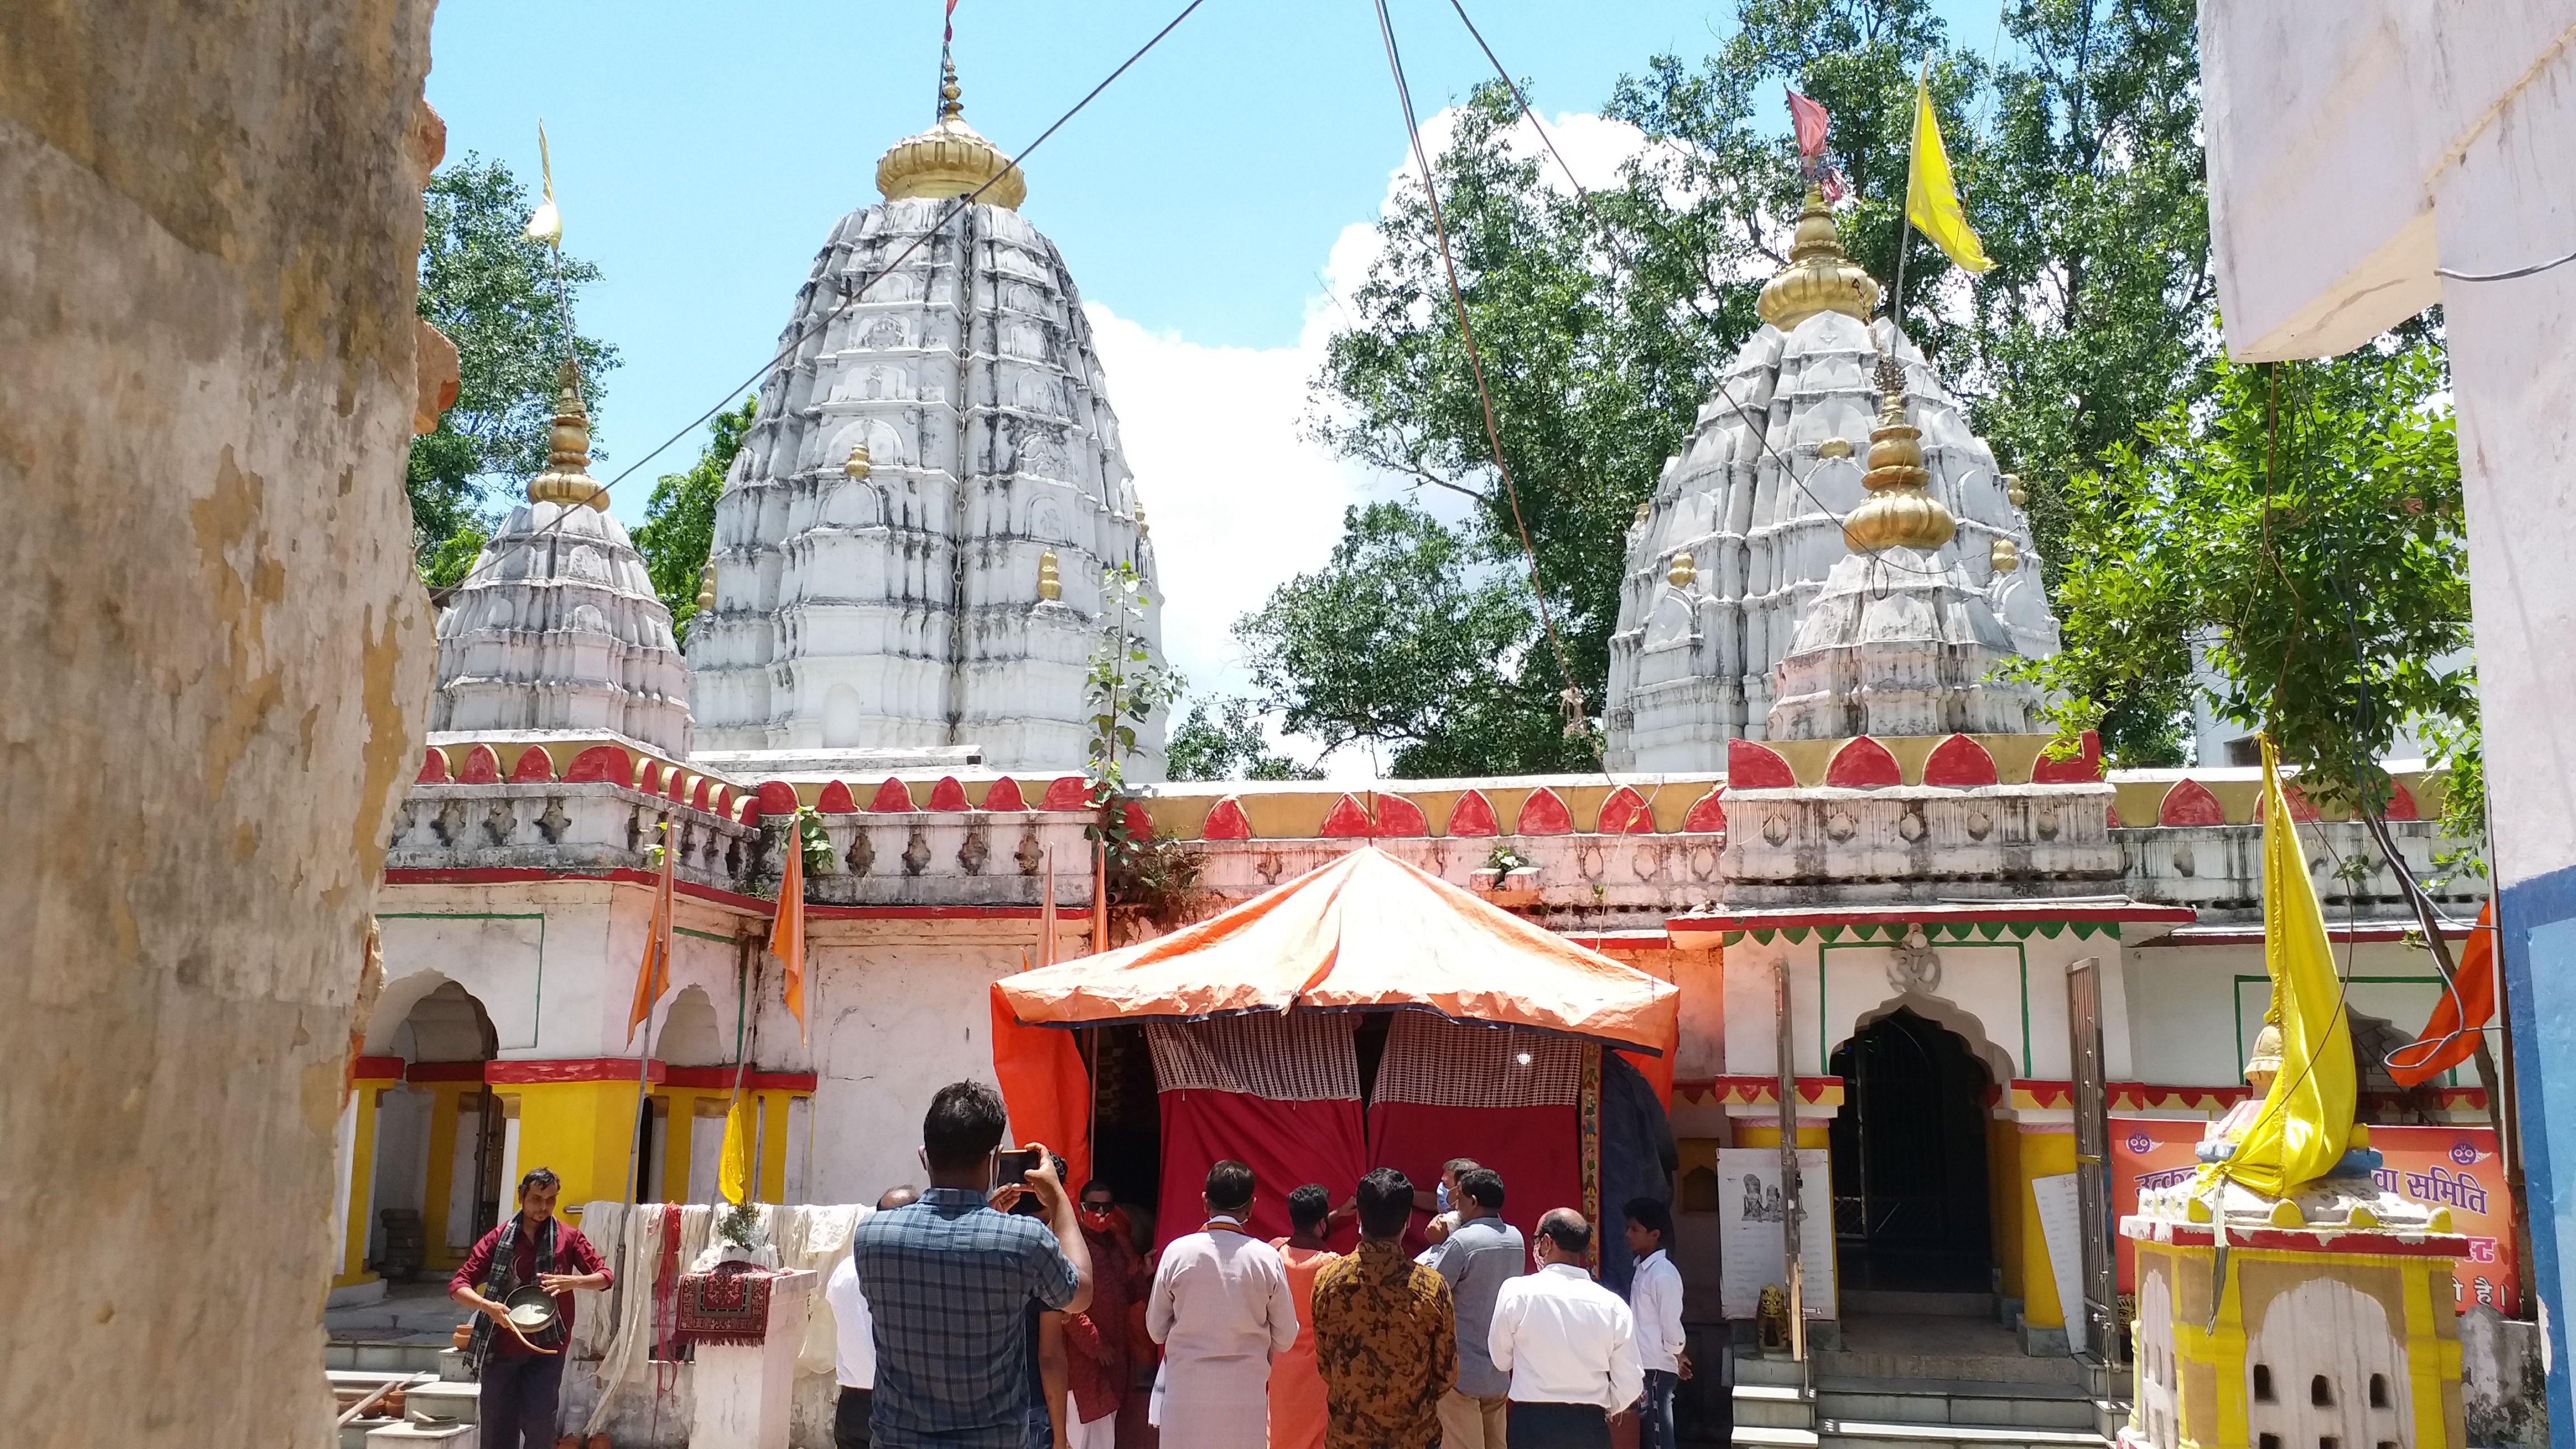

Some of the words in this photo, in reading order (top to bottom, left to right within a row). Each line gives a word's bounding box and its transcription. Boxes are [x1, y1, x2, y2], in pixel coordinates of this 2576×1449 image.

[2133, 1164, 2198, 1199] उत्क
[2371, 1167, 2400, 1195] वा
[2404, 1164, 2488, 1215] समिति
